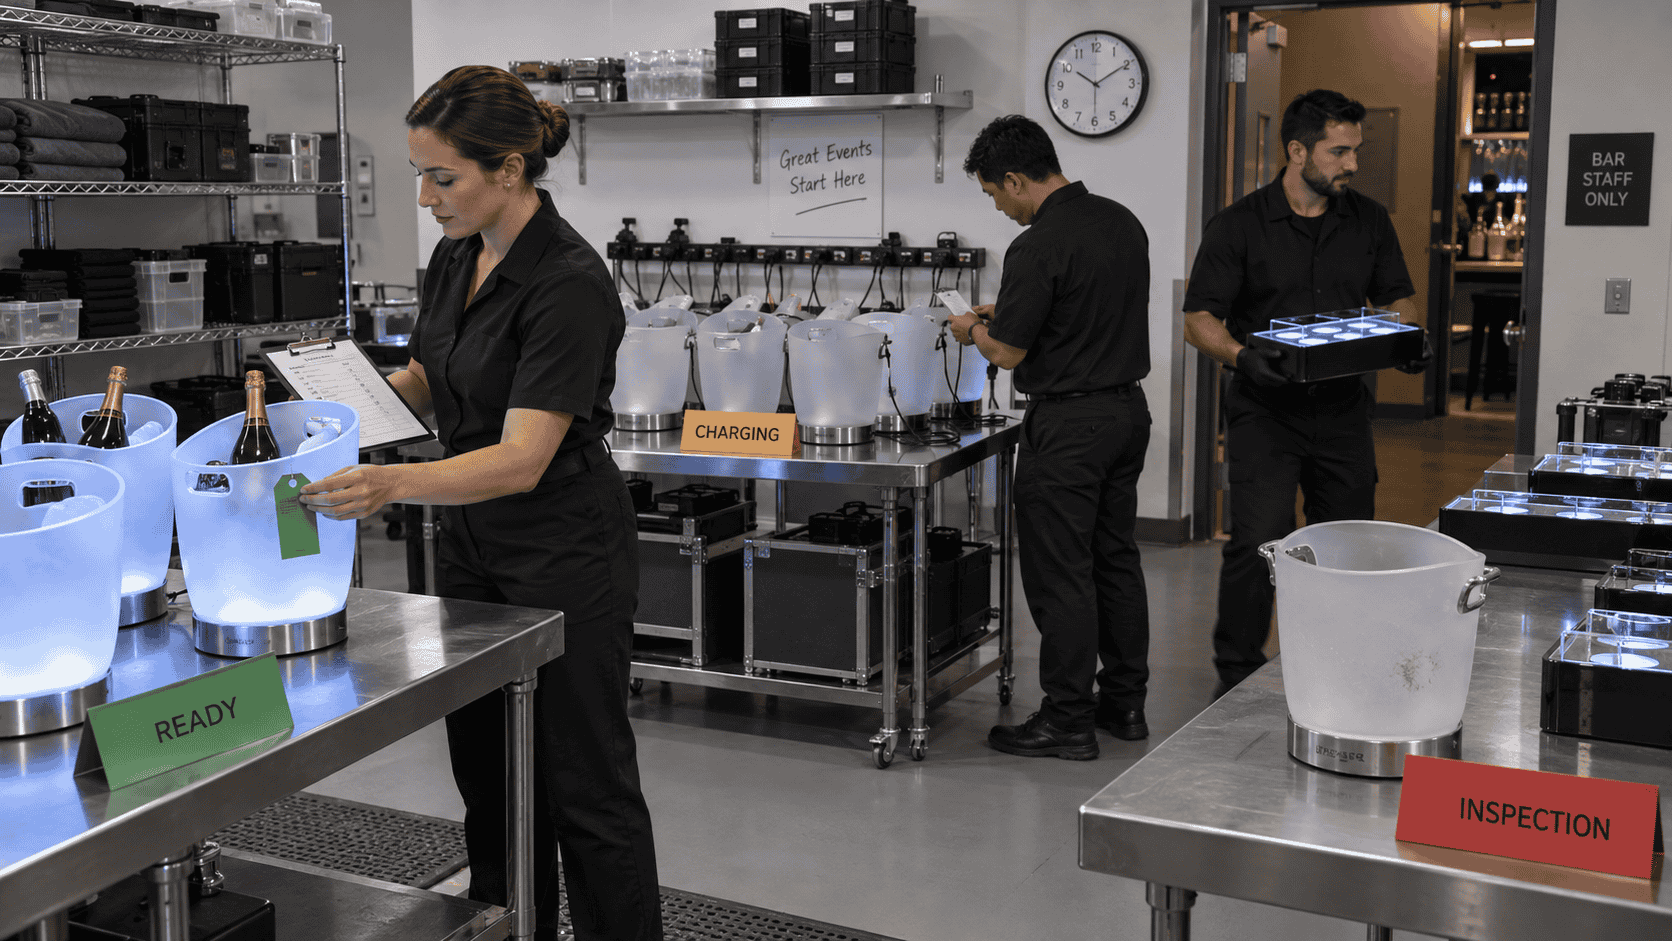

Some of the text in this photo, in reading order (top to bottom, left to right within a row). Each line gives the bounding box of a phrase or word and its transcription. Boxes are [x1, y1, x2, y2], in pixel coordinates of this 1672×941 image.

[1091, 42, 1102, 53] 12
[1075, 49, 1083, 59] 11
[1063, 63, 1072, 73] 10
[1123, 59, 1130, 70] 2
[1057, 81, 1064, 91] 9
[1128, 78, 1135, 89] 3
[1062, 99, 1069, 109] 8
[1122, 97, 1129, 107] 4
[1075, 111, 1082, 122] 7
[1091, 116, 1098, 127] 6
[1109, 111, 1116, 121] 5
[780, 139, 873, 171] Great Events
[1592, 152, 1625, 167] BAR
[790, 169, 866, 195] Start Here
[1582, 171, 1633, 187] STAFF
[1584, 191, 1629, 207] ONLY
[695, 424, 780, 442] CHARGING
[154, 695, 237, 744] READY
[1460, 797, 1611, 841] INSPECTION
